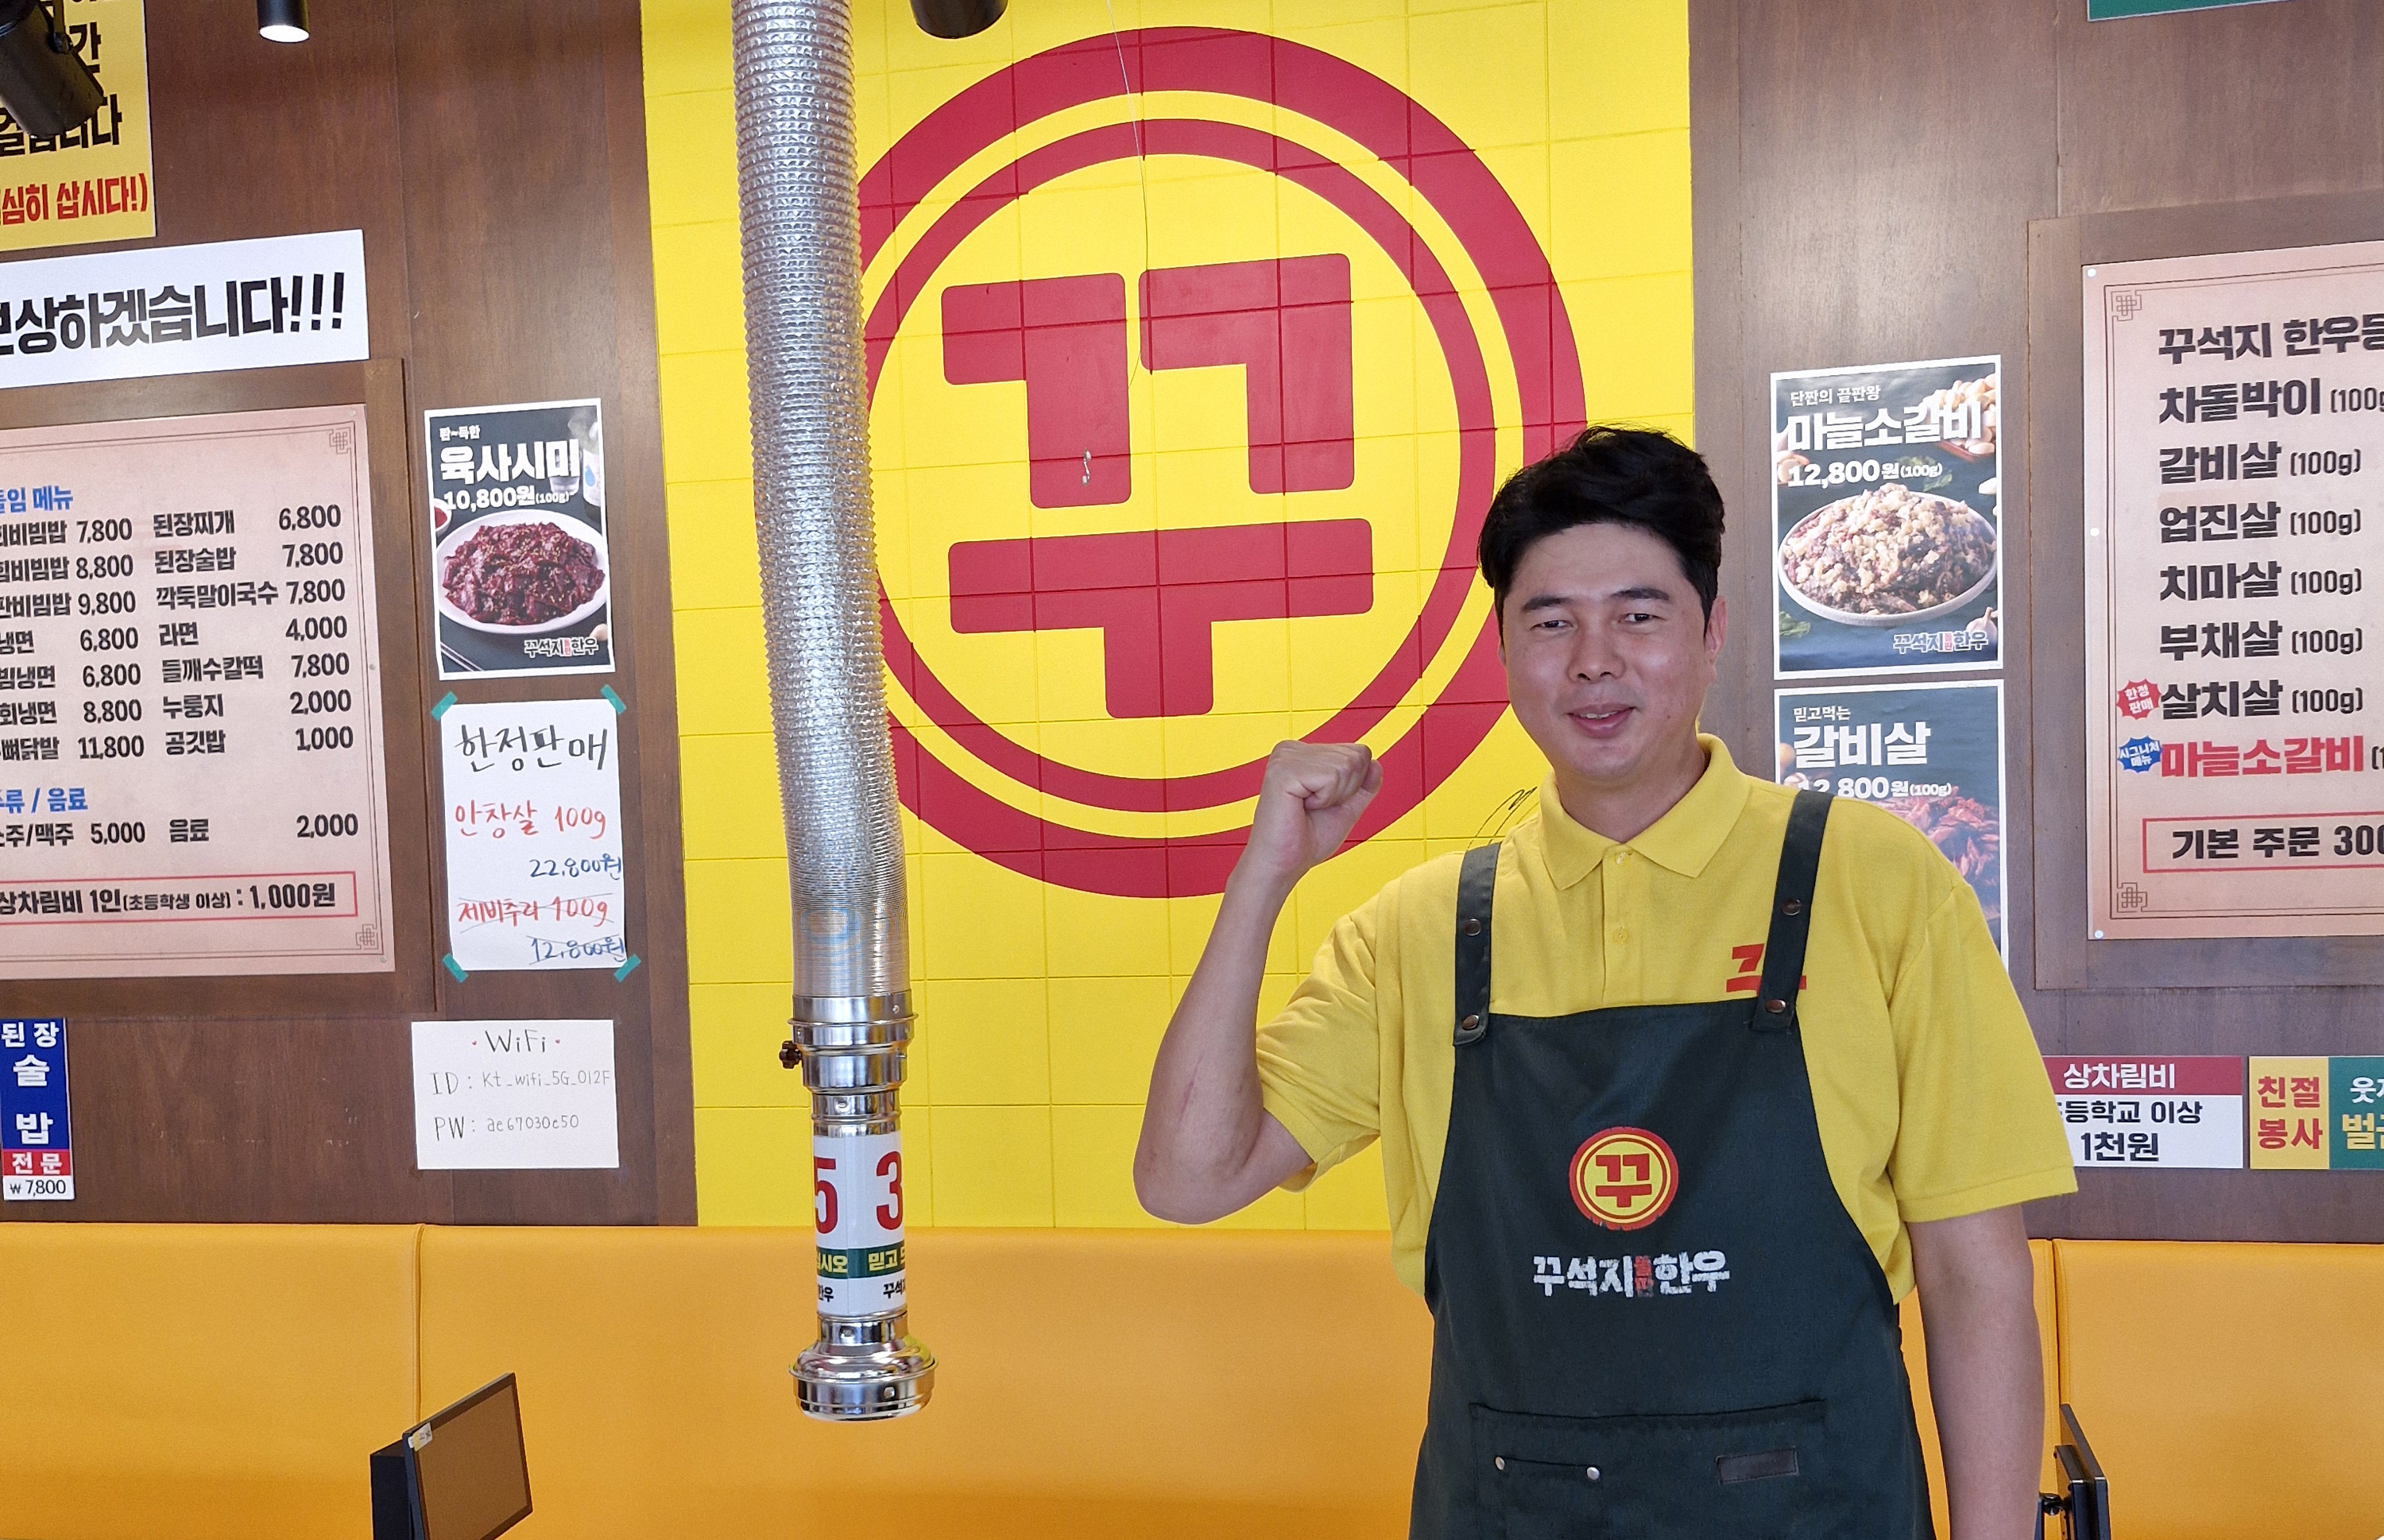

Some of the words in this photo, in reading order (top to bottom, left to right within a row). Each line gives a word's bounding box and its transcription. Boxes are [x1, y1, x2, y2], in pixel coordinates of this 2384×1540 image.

[0, 184, 49, 226] 심히
[56, 172, 148, 221] 삽시다!)
[2158, 322, 2272, 365] 꾸석지
[1790, 389, 1833, 407] 단짠의
[1837, 385, 1881, 404] 끝판왕
[2159, 377, 2320, 424] 차돌박이
[1787, 403, 1982, 451] 마늘소갈비
[440, 439, 580, 485] 육사시미
[2159, 441, 2281, 484] 갈비살
[2290, 449, 2361, 477] (100g)
[33, 486, 73, 510] 메뉴
[941, 253, 1374, 718] 꾸
[76, 518, 133, 544] 7,800
[153, 510, 234, 538] 된장찌개
[279, 505, 342, 531] 6,800
[2159, 501, 2281, 543] 업진살
[2290, 509, 2361, 536] (100g)
[76, 554, 134, 579] 8,800
[155, 547, 236, 574] 된장술밥
[282, 542, 343, 567] 7,800
[157, 581, 278, 610] 깍둑말이국수
[286, 578, 346, 605] 7,800
[2159, 561, 2281, 601] 치마살
[2291, 569, 2362, 595] (100g)
[78, 590, 136, 617] 9,800
[80, 627, 138, 652] 6,800
[159, 621, 199, 646] 라면
[285, 615, 347, 641] 4,000
[2160, 620, 2282, 661] 부채살
[2292, 628, 2363, 655] (100g)
[83, 663, 141, 688] 6,800
[162, 655, 264, 683] 들깨수칼떡
[291, 652, 350, 678] 7,800
[163, 694, 224, 718] 누룽지
[289, 689, 351, 715] 2,000
[2125, 684, 2150, 701] 한정
[2129, 698, 2154, 714] 판매
[2161, 679, 2283, 720] 살치살
[2292, 687, 2363, 714] (100g)
[83, 699, 141, 724] 8,800
[1794, 706, 1852, 722] 믿고먹는
[78, 735, 145, 760] 11,800
[165, 729, 226, 755] 공깃밥
[295, 726, 354, 751] 1,000
[455, 725, 608, 772] 한정판매
[1794, 722, 1931, 768] 갈비살
[2119, 741, 2161, 759] 시그니처
[2131, 755, 2153, 767] 메뉴
[2161, 735, 2364, 778] 마늘소갈비
[0, 788, 25, 814] 류
[47, 787, 88, 812] 음료
[169, 818, 210, 842] 음료
[296, 814, 358, 838] 2,000
[455, 799, 538, 839] 안창살
[554, 806, 606, 840] 100g
[0, 822, 74, 848] 주/맥주
[90, 822, 145, 845] 5,000
[2172, 830, 2239, 860] 기본
[2253, 826, 2320, 857] 주문
[250, 883, 335, 909] 1,000원
[2, 1022, 60, 1047] 된장
[485, 1028, 546, 1053] WiFi
[2063, 1063, 2176, 1089] 상차림비
[2257, 1076, 2321, 1109] 친절
[2058, 1101, 2140, 1124] 등학교
[2151, 1101, 2203, 1124] 이상
[2257, 1117, 2324, 1151] 봉사
[2342, 1112, 2384, 1150] 벌
[2080, 1132, 2160, 1162] 1천원
[12, 1152, 62, 1174] 전문
[1596, 1153, 1652, 1208] 꾸
[817, 1252, 848, 1274] 시오
[869, 1248, 898, 1271] 믿고
[1534, 1256, 1634, 1298] 꾸석지
[1653, 1250, 1730, 1294] 한우
